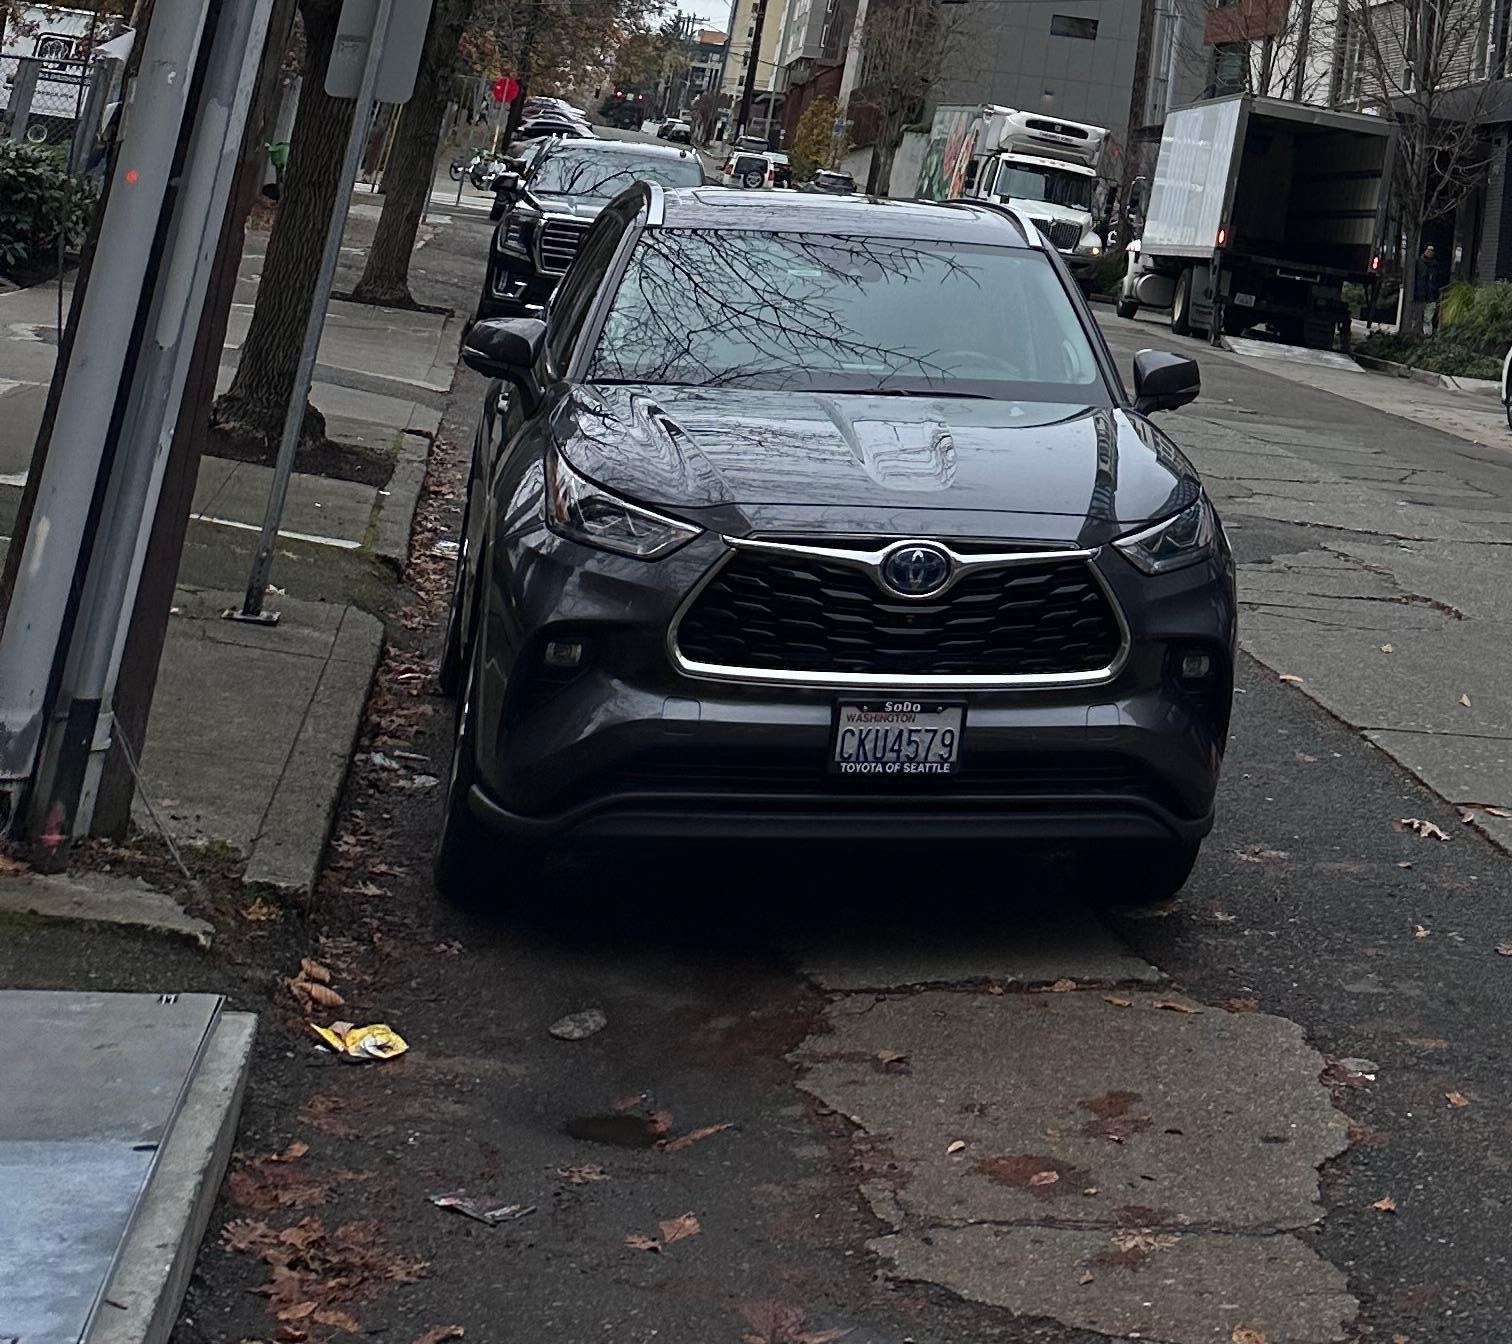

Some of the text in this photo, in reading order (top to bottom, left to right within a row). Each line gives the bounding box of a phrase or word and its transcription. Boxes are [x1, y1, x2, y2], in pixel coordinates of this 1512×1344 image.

[885, 701, 921, 712] SoDo
[846, 713, 916, 723] WASHINGTON
[840, 727, 955, 762] CKU4579
[841, 762, 951, 773] TOYOTA OF SEATTLE
